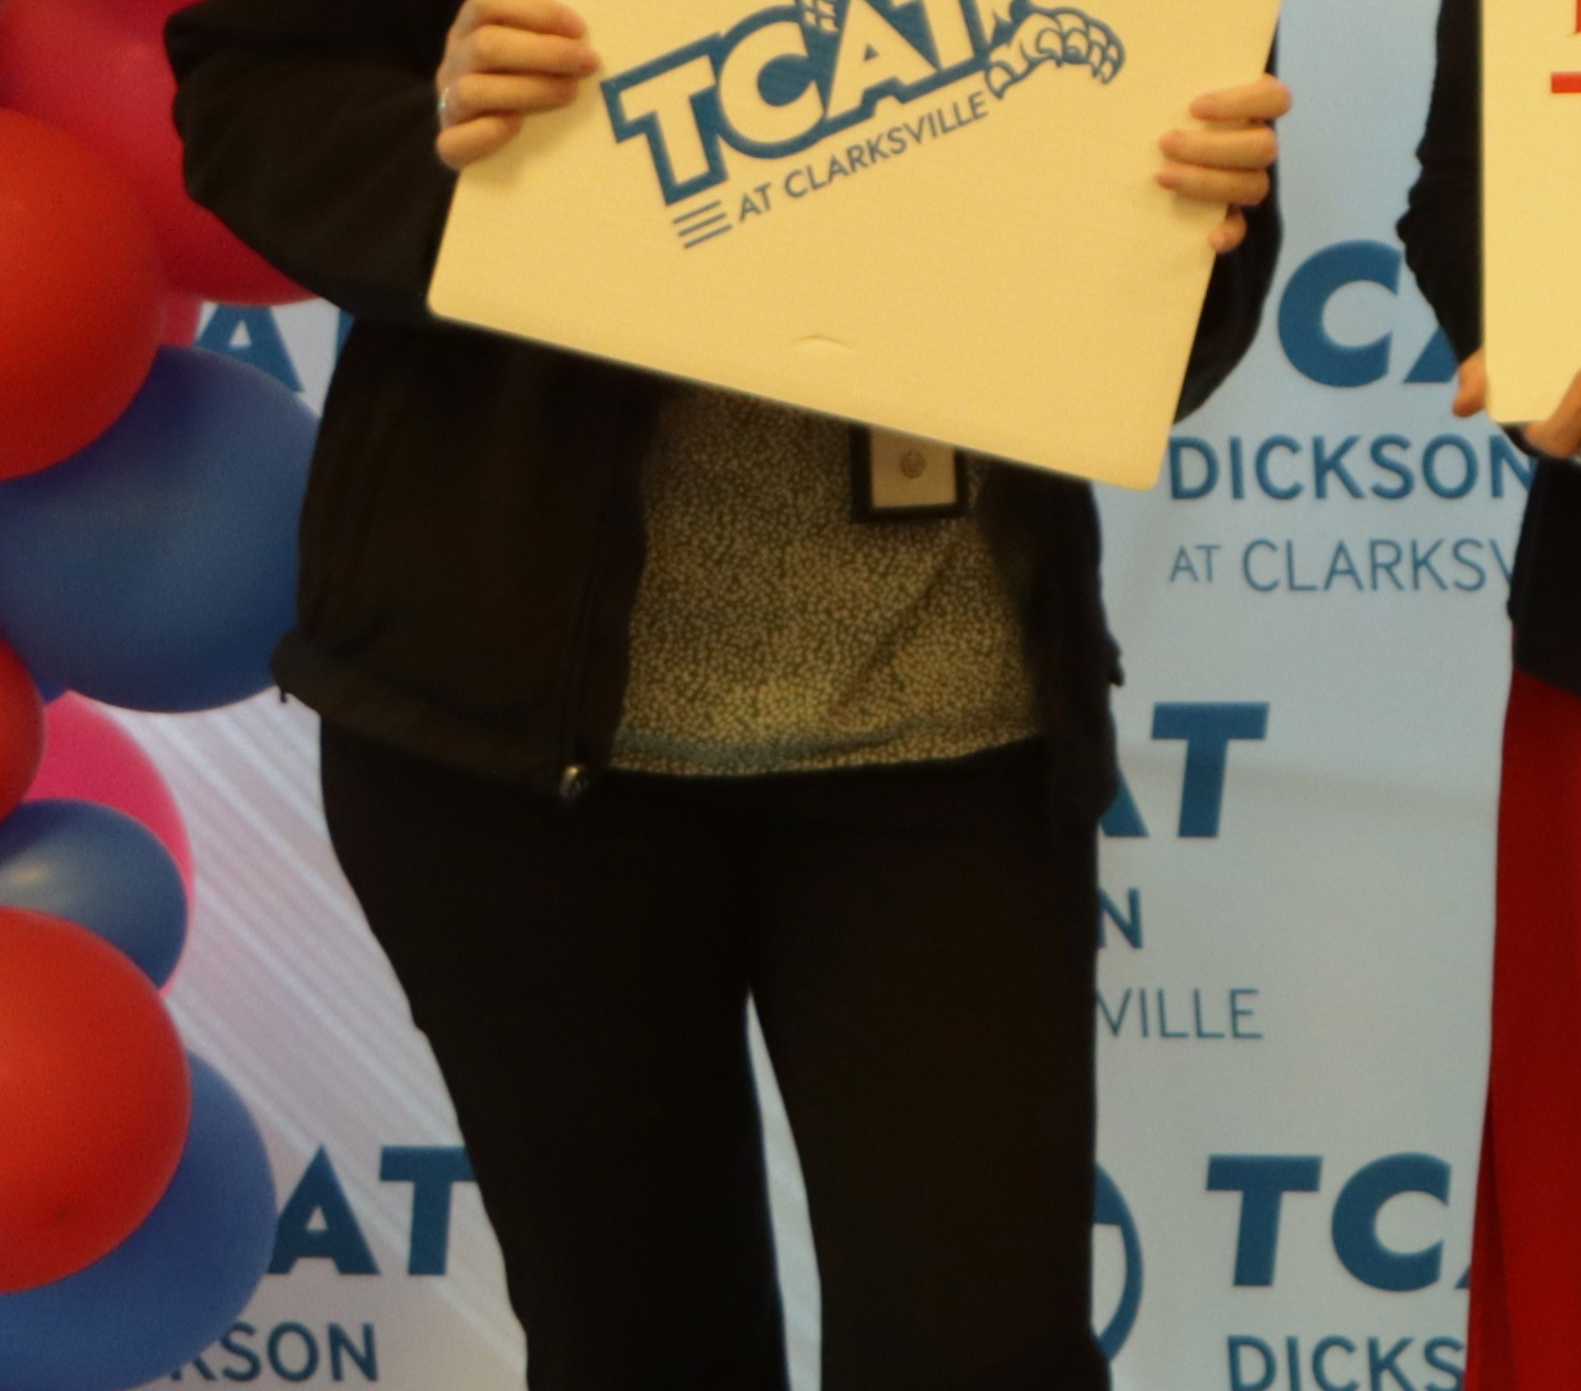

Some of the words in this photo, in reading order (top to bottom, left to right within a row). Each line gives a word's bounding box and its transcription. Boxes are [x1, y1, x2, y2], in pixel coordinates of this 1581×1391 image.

[737, 181, 773, 224] AT
[783, 90, 990, 199] CLARKSVILLE
[1168, 432, 1540, 502] DICKSON
[1168, 544, 1222, 584] AT
[1242, 537, 1512, 593] CLARKS
[266, 1144, 477, 1277] AT
[1205, 1151, 1471, 1293] TC
